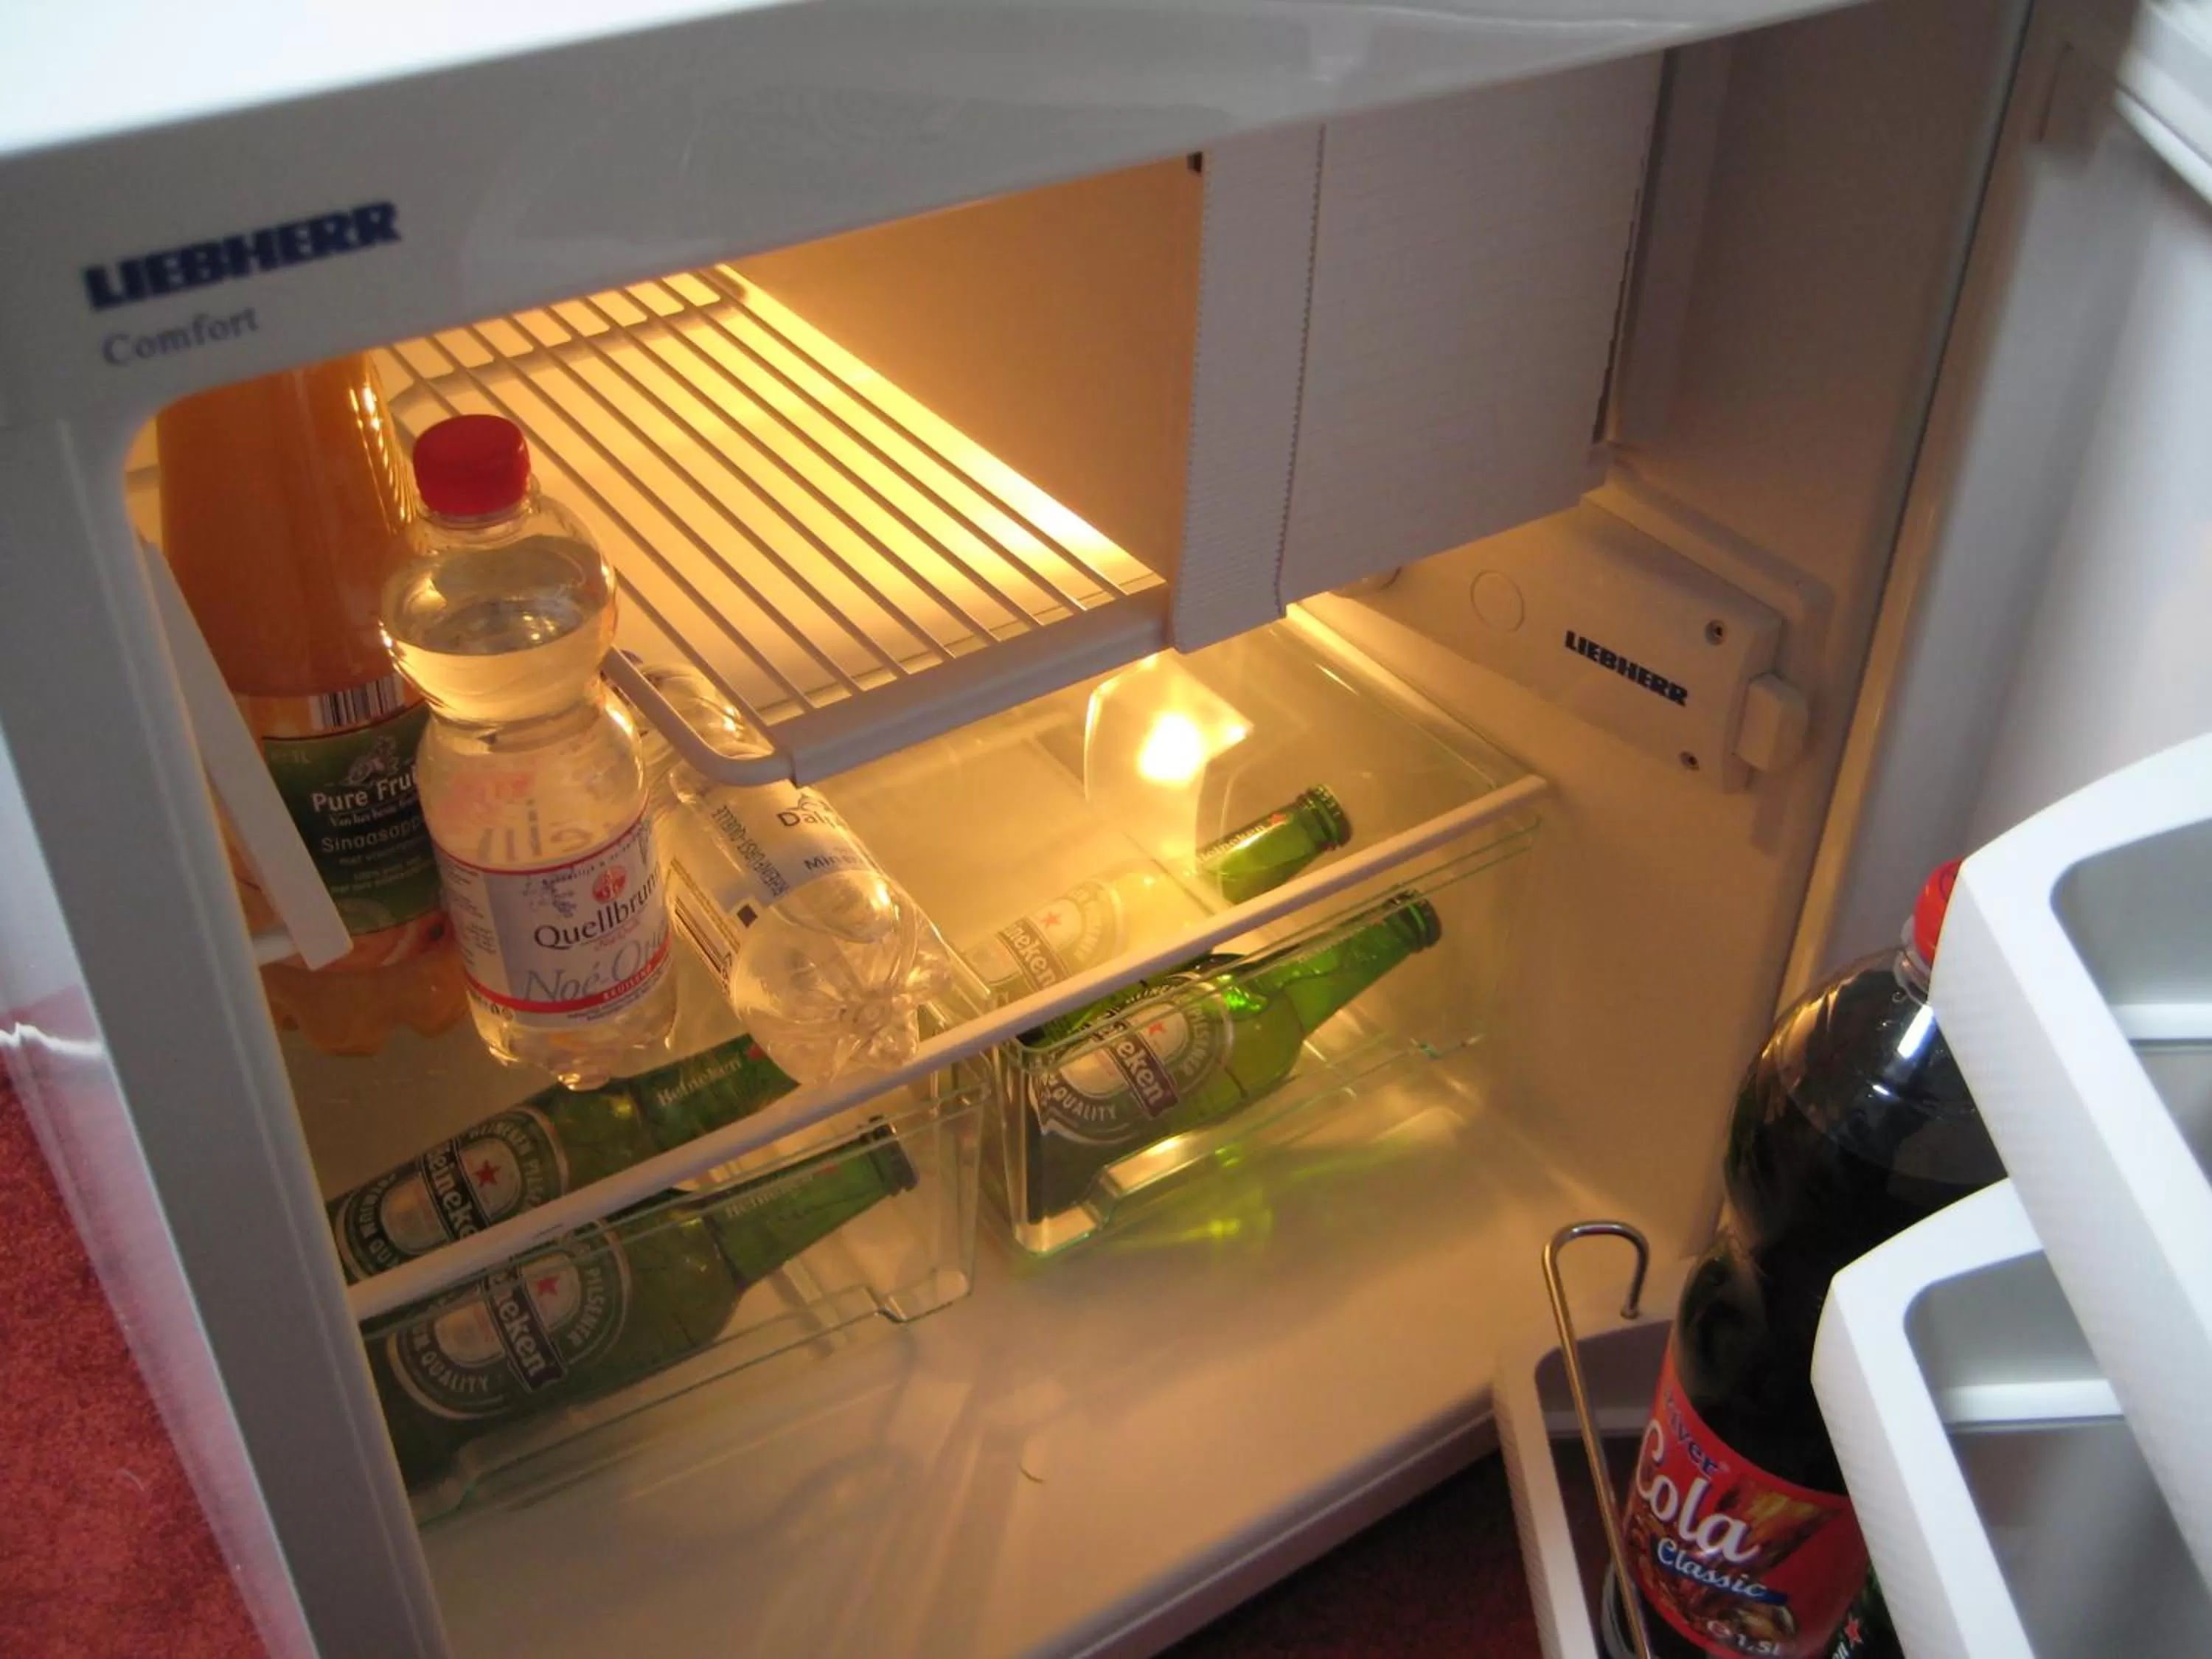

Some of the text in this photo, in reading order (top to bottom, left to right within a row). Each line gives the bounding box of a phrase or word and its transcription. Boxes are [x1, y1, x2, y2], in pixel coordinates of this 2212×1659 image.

[83, 201, 402, 313] LIEBHERR
[102, 307, 258, 366] Comfort
[1565, 629, 1688, 707] LIEBHERR
[310, 790, 369, 813] Pure
[1052, 1084, 1116, 1122] QUALITY
[419, 1346, 490, 1393] QUALITY
[1635, 1419, 1760, 1562] Cola
[1657, 1537, 1771, 1598] Classic
